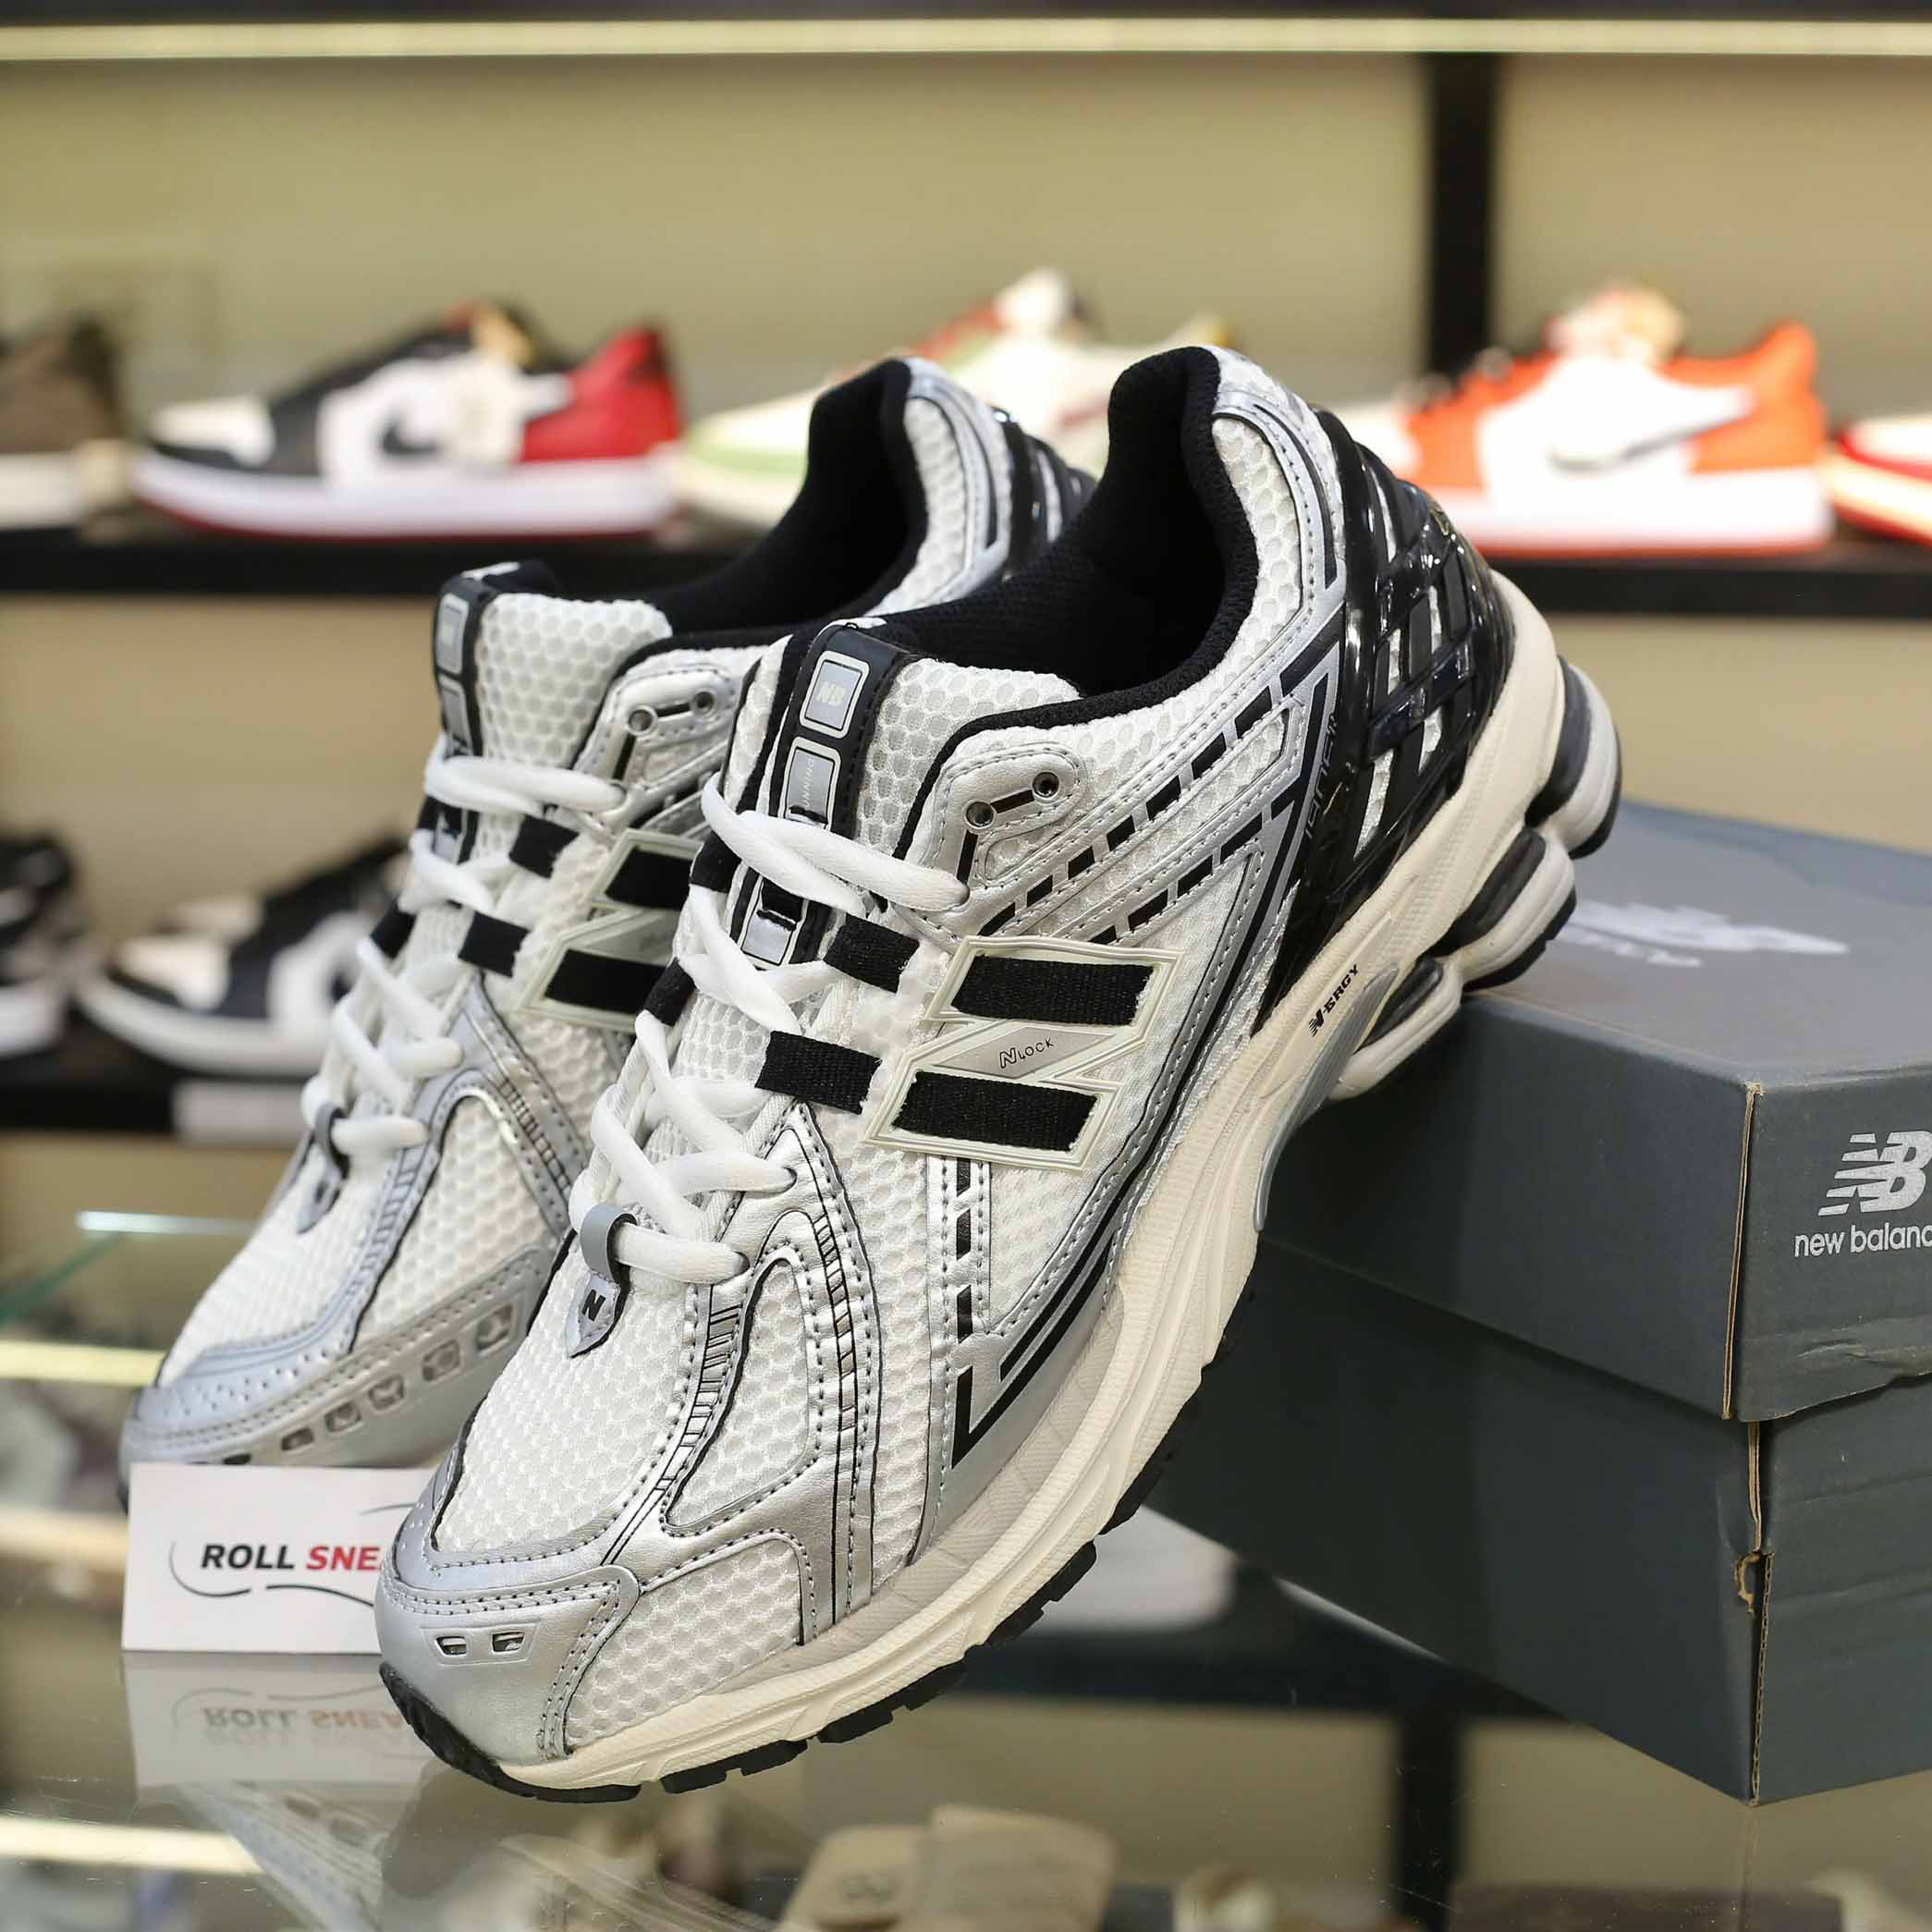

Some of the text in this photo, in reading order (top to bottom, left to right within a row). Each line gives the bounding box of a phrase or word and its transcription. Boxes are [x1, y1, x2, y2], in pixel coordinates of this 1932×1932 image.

[1794, 1231, 1845, 1257] new
[581, 1289, 606, 1313] N
[201, 1544, 384, 1571] ROLL SNE
